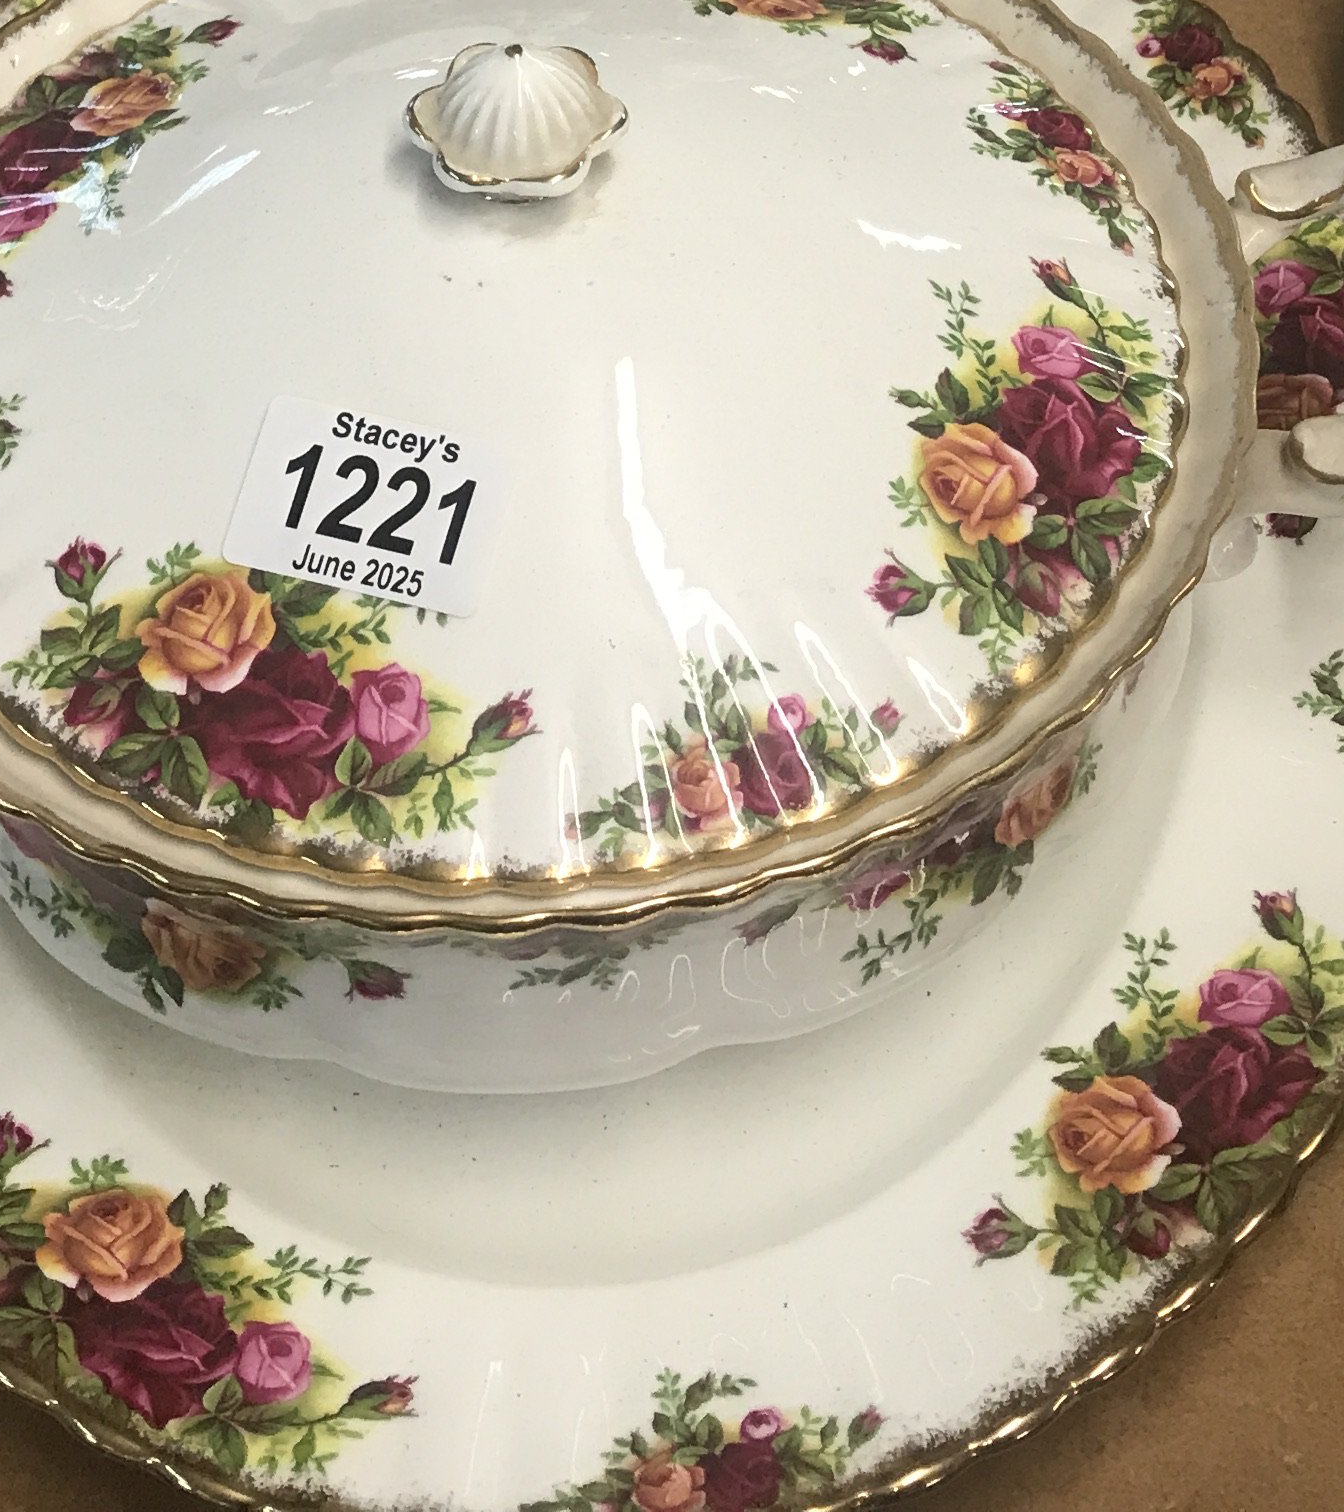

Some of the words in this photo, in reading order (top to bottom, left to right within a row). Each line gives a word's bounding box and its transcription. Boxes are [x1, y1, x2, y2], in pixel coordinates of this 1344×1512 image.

[332, 412, 460, 463] Stacey's
[285, 444, 477, 566] 1221
[292, 544, 356, 581] June
[361, 558, 424, 597] 2025
